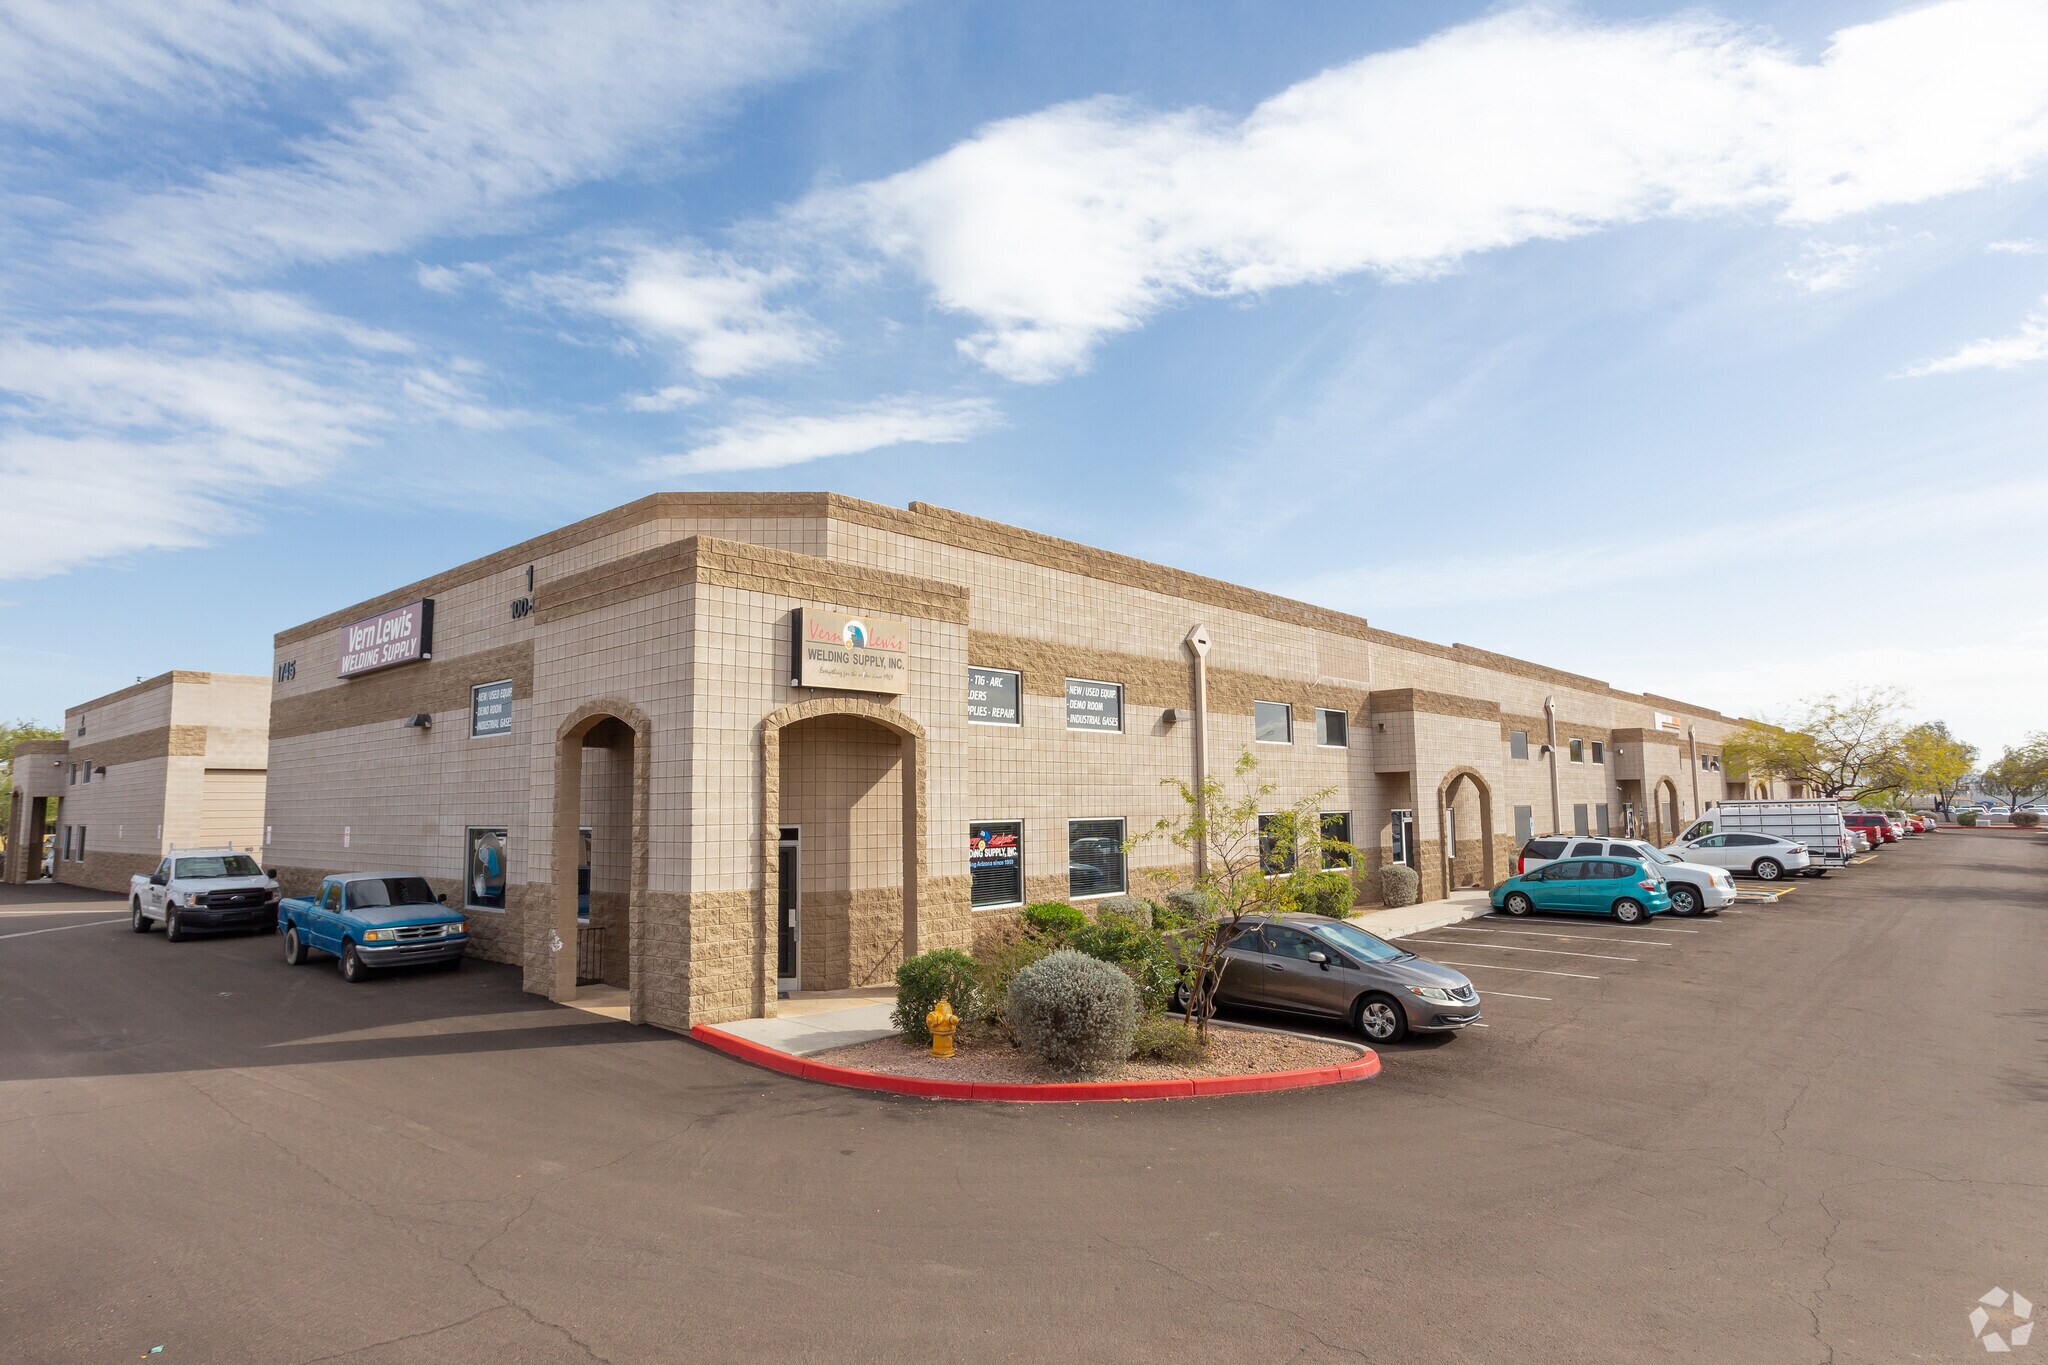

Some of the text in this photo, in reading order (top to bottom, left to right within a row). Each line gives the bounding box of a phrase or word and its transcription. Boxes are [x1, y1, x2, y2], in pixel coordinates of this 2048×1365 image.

[349, 610, 412, 653] Vern Lewis
[809, 617, 903, 650] Vern Lewis
[341, 638, 417, 673] WELDING SUPPLY
[808, 648, 905, 670] WELDING SUPPLY, INC.
[278, 660, 296, 683] 1745
[974, 675, 985, 686] TIG
[989, 677, 1003, 688] ARC
[992, 707, 1015, 719] REPAIR
[1087, 701, 1104, 712] ROOM
[1069, 714, 1119, 727] INDUSTRIAL GASES
[985, 848, 1006, 858] SUPPLY,
[1007, 846, 1018, 857] INC.
